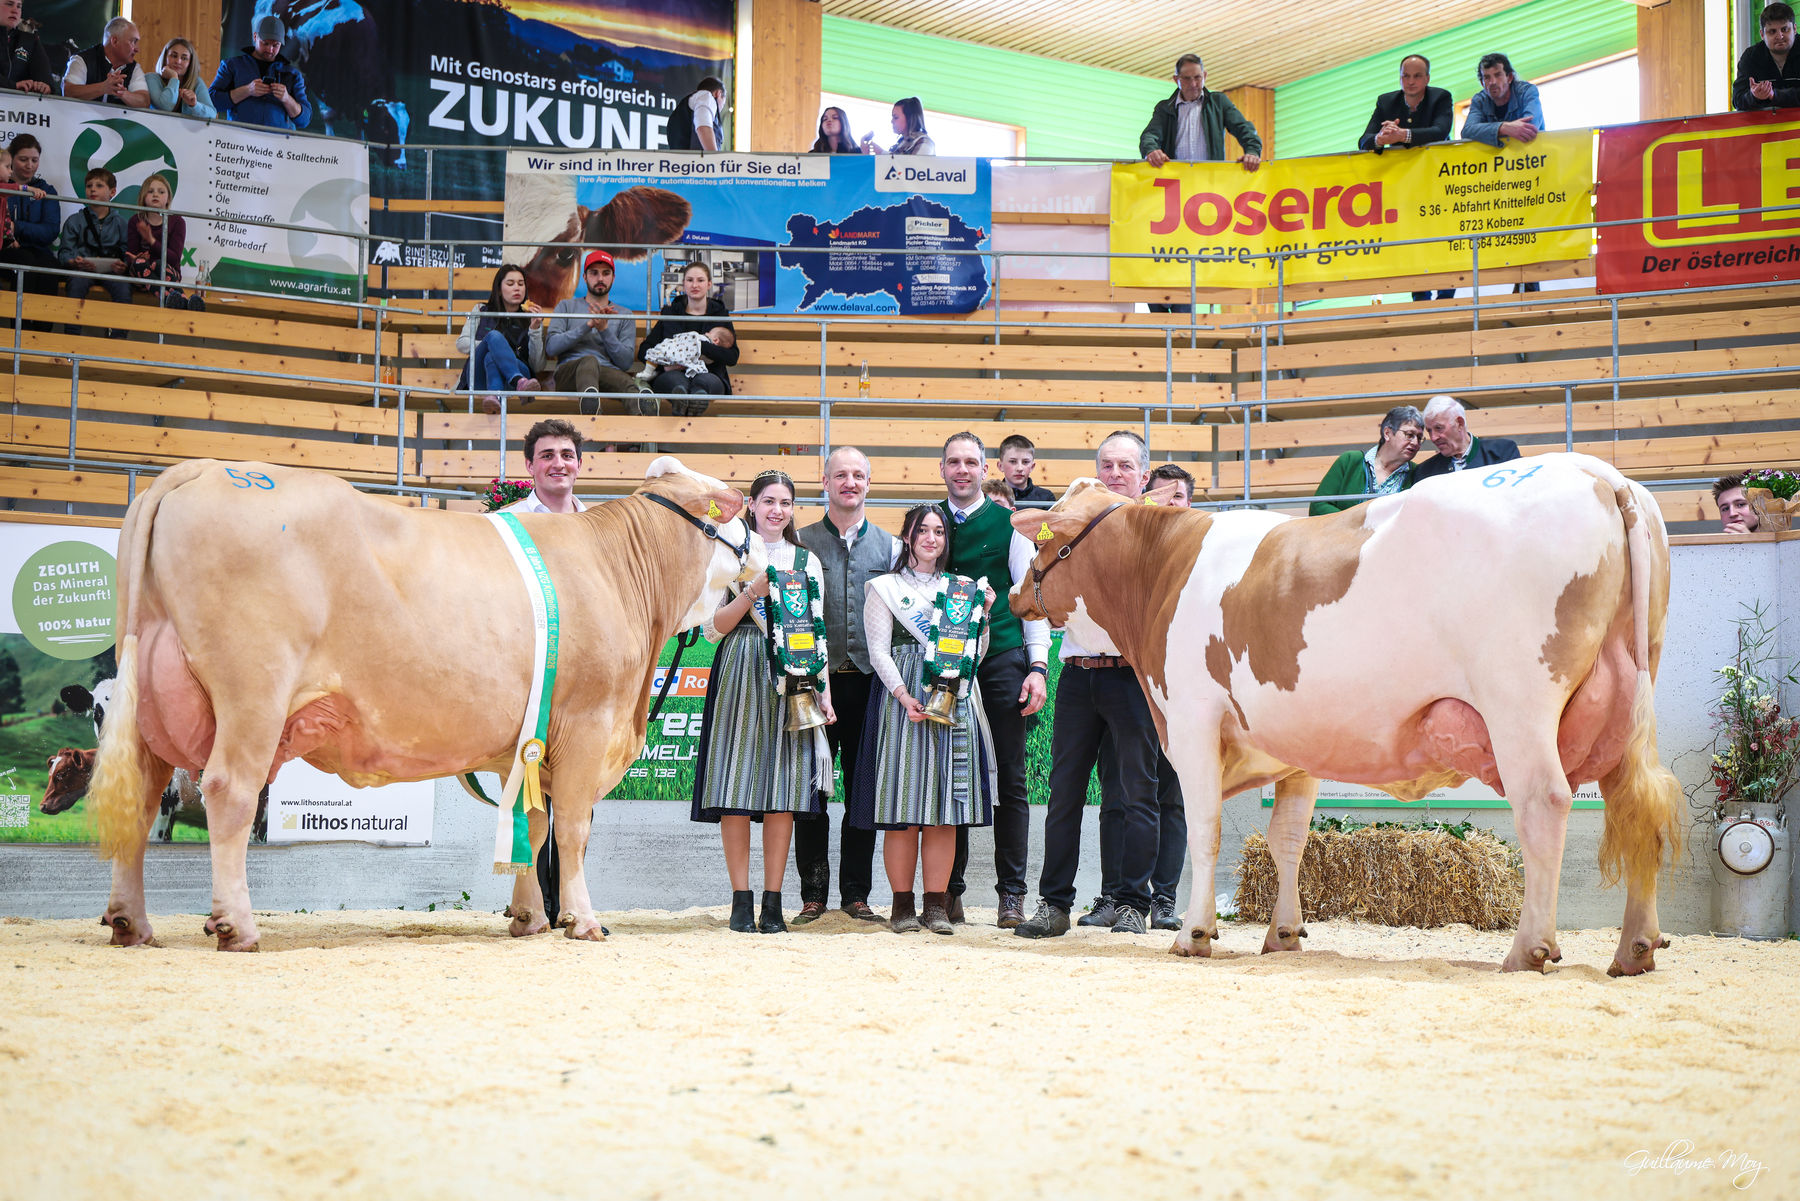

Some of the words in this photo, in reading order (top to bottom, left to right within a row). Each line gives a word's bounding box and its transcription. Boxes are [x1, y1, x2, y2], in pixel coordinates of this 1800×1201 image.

[430, 54, 462, 76] Mit
[467, 62, 556, 92] Genostars
[561, 79, 656, 108] erfolgreich
[661, 93, 677, 111] in
[428, 78, 670, 150] ZUKUNF
[216, 153, 272, 169] Euterhygiene
[246, 144, 273, 157] Weide
[276, 150, 284, 158] &
[286, 152, 338, 164] Stalltechnik
[216, 166, 250, 180] Saatgut
[528, 157, 555, 170] Wir
[560, 158, 592, 171] sind
[598, 159, 612, 171] in
[617, 159, 654, 172] Ihrer
[659, 160, 718, 175] Region
[720, 160, 742, 174] für
[747, 162, 772, 174] Sie
[777, 162, 801, 175] da!
[1438, 161, 1488, 177] Anton
[1494, 154, 1547, 172] Puster
[736, 178, 796, 187] konventionelles
[905, 168, 966, 182] DeLaval
[216, 180, 269, 195] Futtermittel
[1444, 178, 1532, 196] Wegscheiderweg
[1535, 176, 1540, 187] 1
[216, 193, 230, 204] Öle
[1150, 178, 1398, 236] Josera.
[1419, 206, 1426, 217] S
[1429, 204, 1441, 215] 36
[1452, 200, 1490, 214] Abfahrt
[1494, 194, 1545, 209] Knittelfeld
[1548, 191, 1566, 203] Ost
[216, 208, 275, 223] Schmierstoffe
[1460, 220, 1484, 231] 8723
[1486, 216, 1524, 230] Kobenz
[214, 222, 226, 231] Ad
[229, 224, 247, 235] Blue
[214, 235, 267, 253] Agrarbedarf
[1448, 239, 1466, 251] Tel:
[1495, 232, 1537, 247] 3245903
[405, 246, 466, 262] RINDERZUHT
[1151, 246, 1189, 264] we
[1266, 242, 1308, 269] you
[1317, 237, 1382, 264] grow
[1642, 255, 1681, 274] Der
[270, 279, 351, 295] www.agrarfux.at
[814, 303, 896, 312] www.delaval.com
[224, 468, 275, 490] 59
[38, 560, 100, 577] ZEOLITH
[32, 580, 56, 592] Das
[60, 576, 108, 590] Mineral
[32, 594, 54, 606] der
[57, 589, 111, 604] Zukunft!
[38, 620, 71, 632] 100%
[76, 616, 111, 628] Natur
[654, 768, 676, 777] 132
[302, 812, 348, 830] lithos
[351, 815, 408, 830] natural
